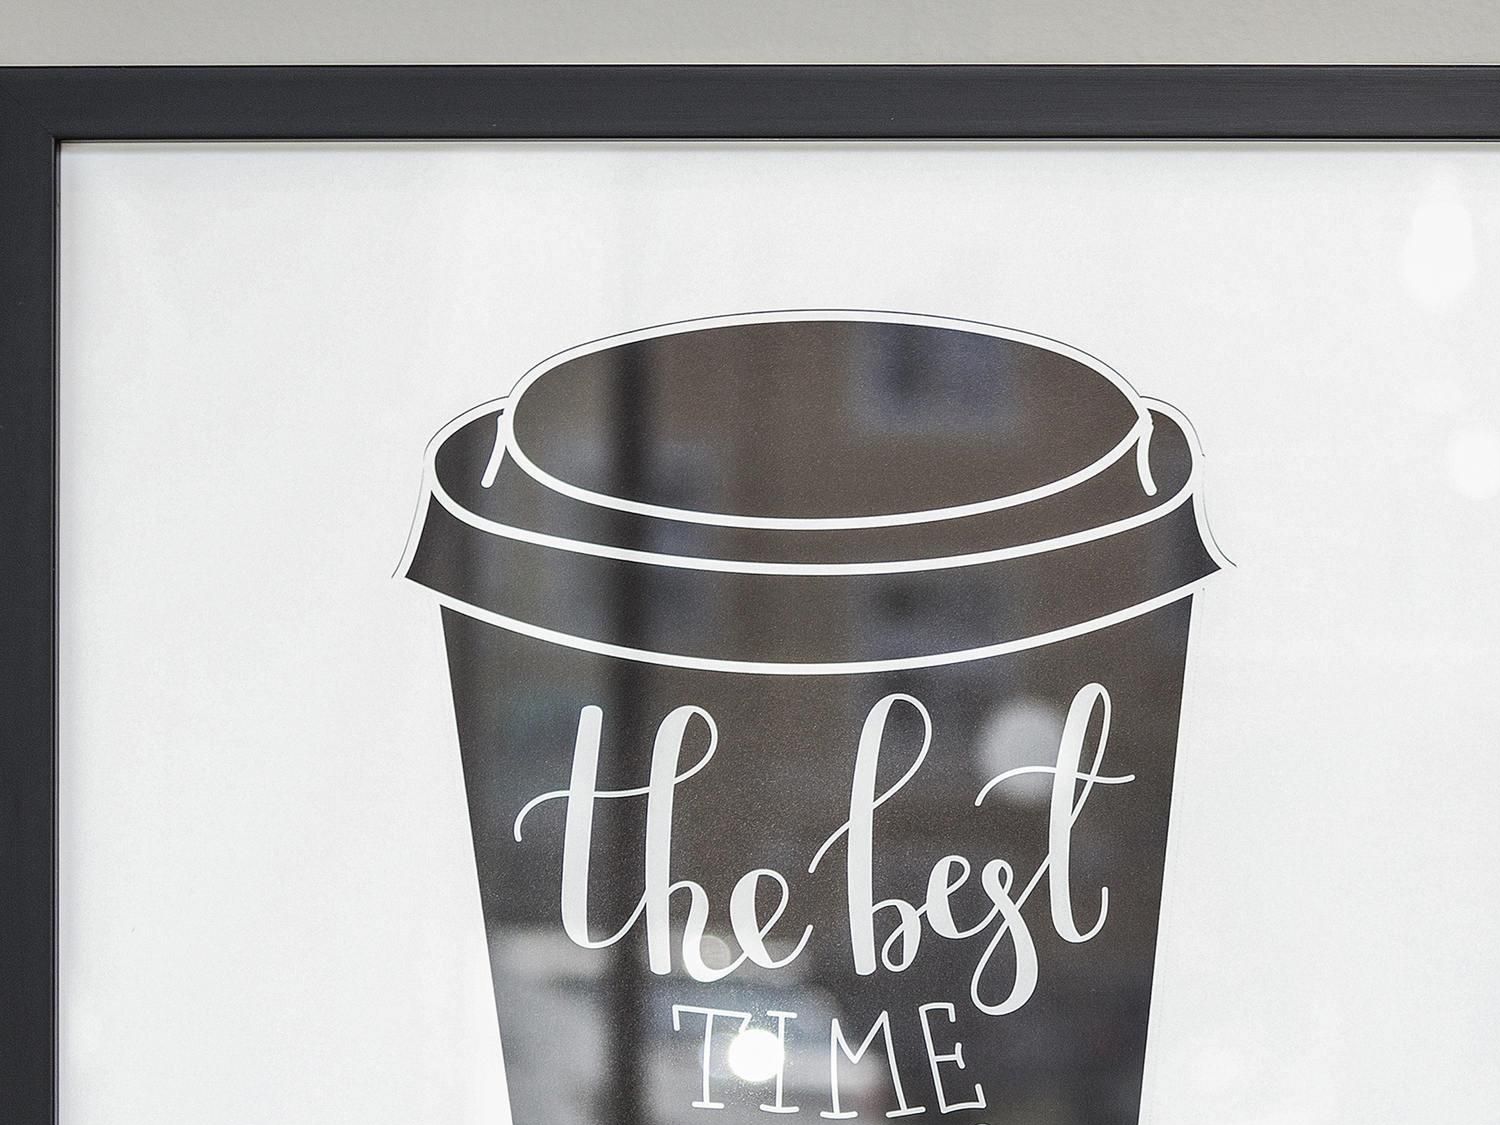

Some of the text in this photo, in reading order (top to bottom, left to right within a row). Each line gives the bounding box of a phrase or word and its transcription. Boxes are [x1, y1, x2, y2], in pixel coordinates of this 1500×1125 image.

[513, 682, 1137, 1017] the best
[671, 1002, 988, 1120] TIME
